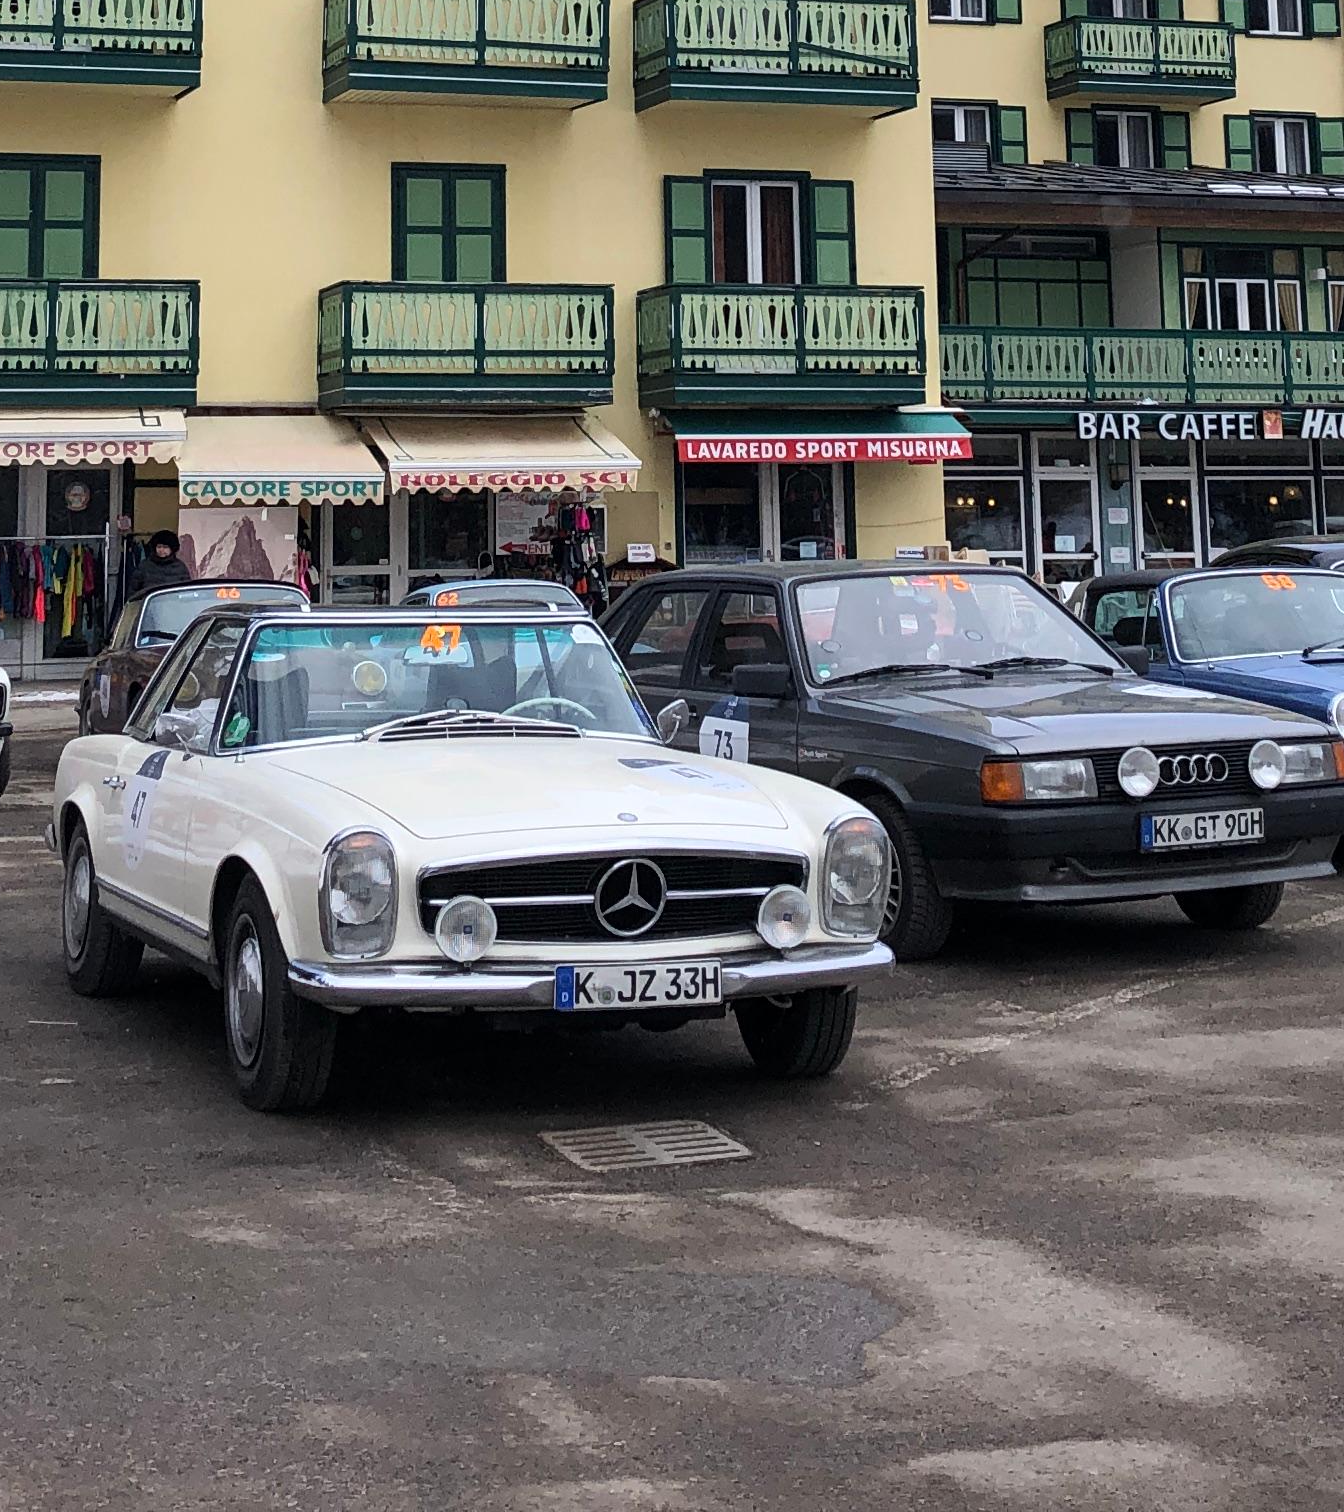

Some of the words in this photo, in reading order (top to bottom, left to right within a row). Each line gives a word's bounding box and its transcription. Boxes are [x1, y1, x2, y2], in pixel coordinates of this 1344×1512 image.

[1077, 411, 1142, 441] BAR
[64, 440, 155, 459] SPORT
[686, 442, 787, 459] LAVAREDO
[795, 441, 859, 458] SPORT
[867, 440, 963, 457] MISURINA
[399, 471, 567, 487] NOLEGGIO
[579, 471, 629, 485] SCI
[182, 480, 291, 498] CADORE
[300, 480, 383, 498] SPORT
[713, 729, 734, 760] 73
[1153, 817, 1181, 844] KK
[1194, 814, 1220, 840] GT
[1224, 810, 1263, 838] 90H
[574, 971, 595, 1005] K
[617, 969, 657, 1003] JZ
[664, 965, 720, 1000] 33H
[561, 991, 569, 1003] D
